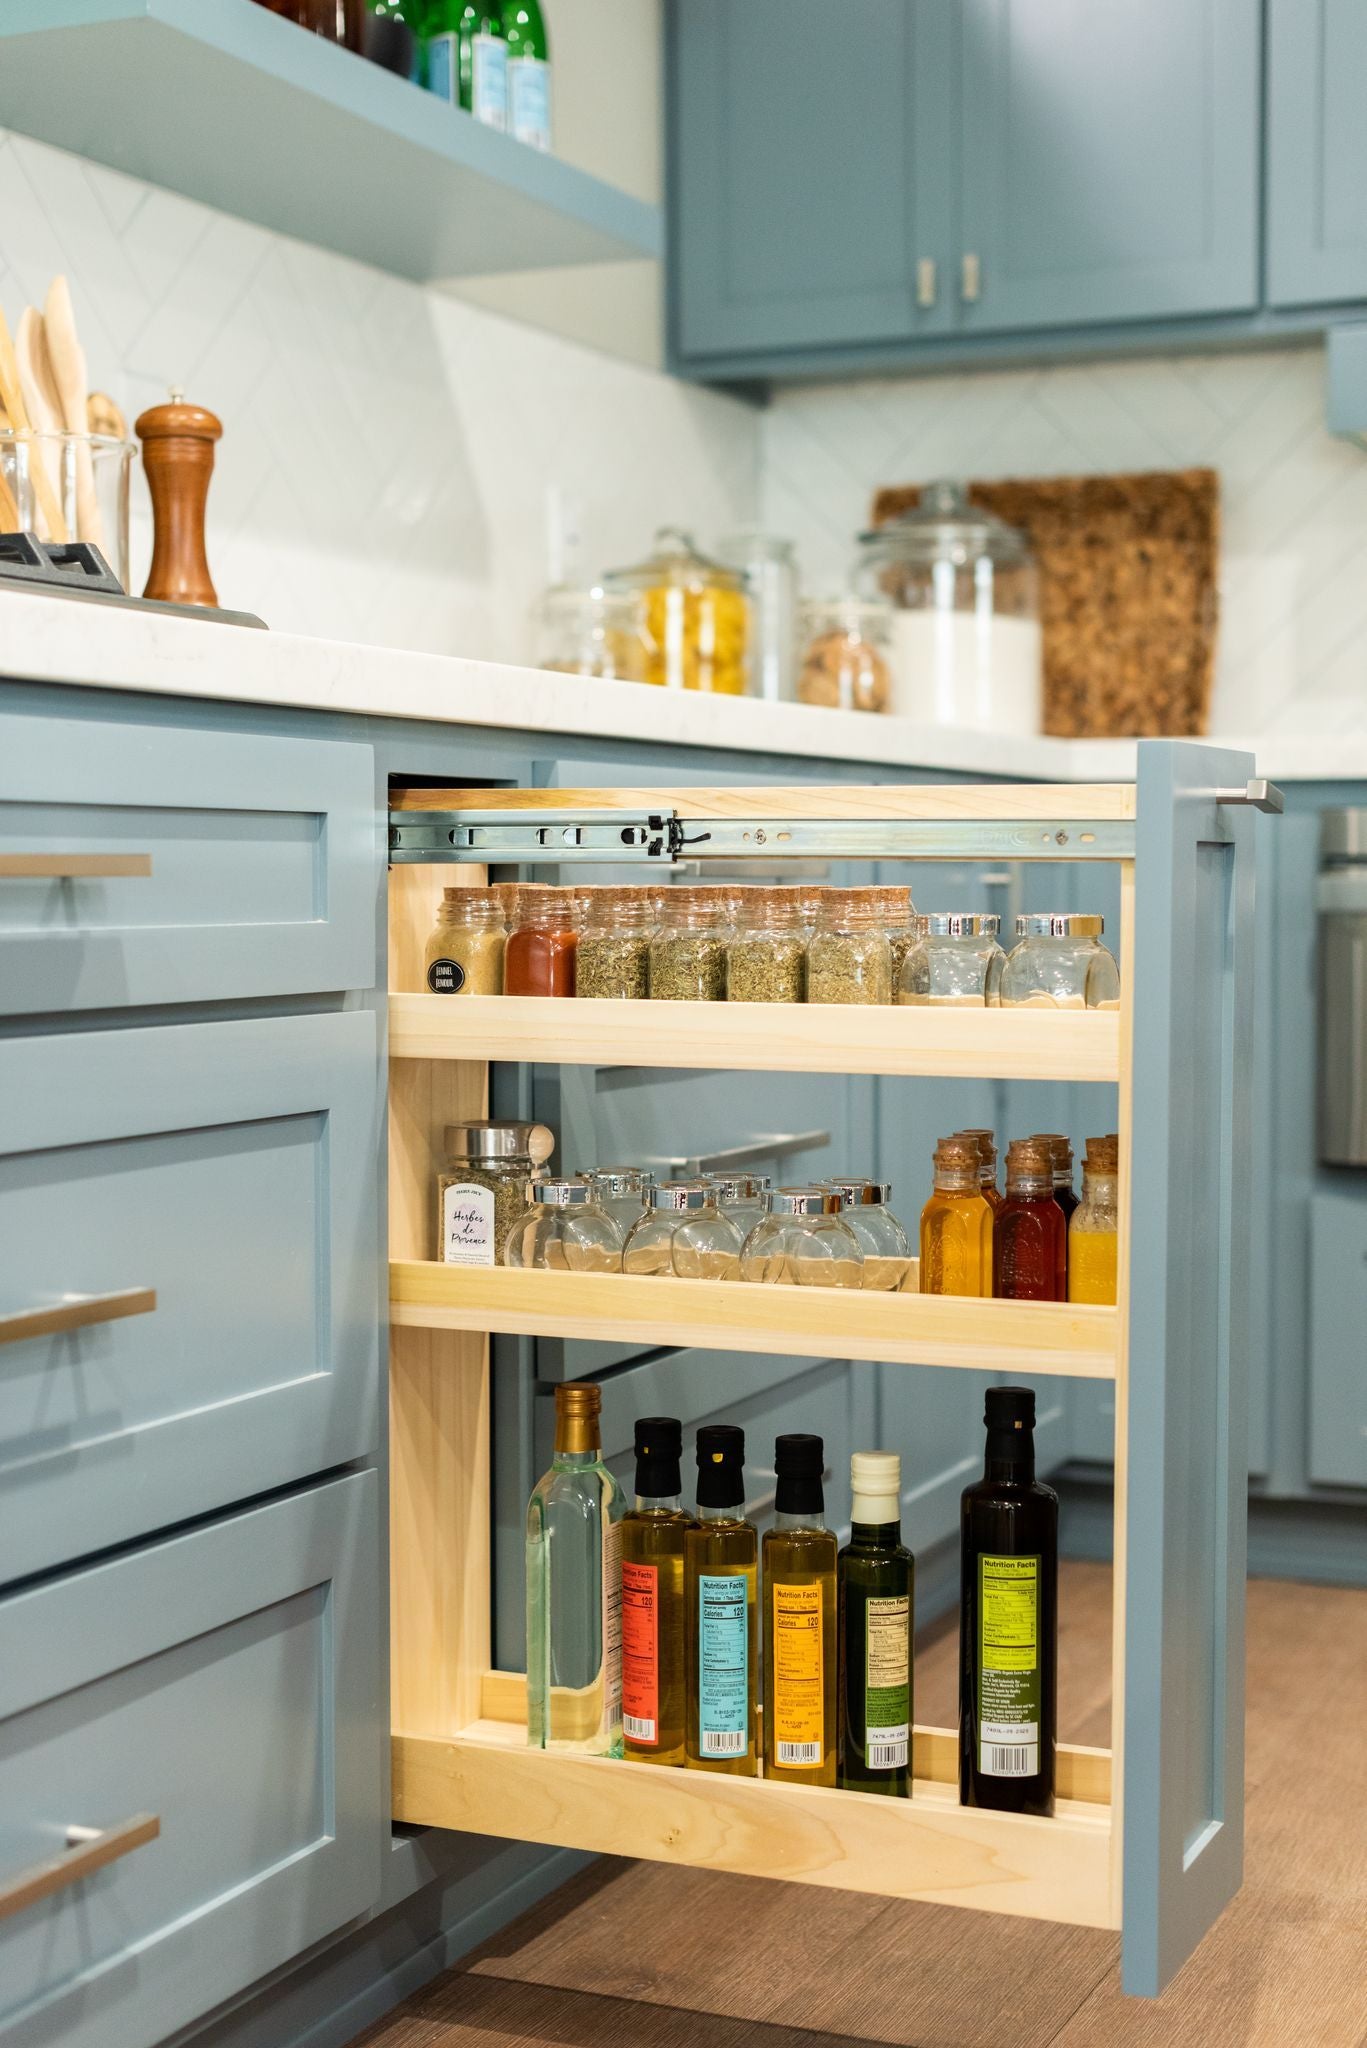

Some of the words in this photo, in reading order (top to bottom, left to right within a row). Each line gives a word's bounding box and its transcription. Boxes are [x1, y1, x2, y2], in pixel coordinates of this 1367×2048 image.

[453, 1210, 484, 1222] Herbes
[462, 1223, 474, 1234] de
[451, 1233, 487, 1245] Provence
[984, 1560, 1015, 1568] Nutrition
[704, 1582, 728, 1590] Nutrition
[778, 1591, 801, 1599] Nutrition
[642, 1596, 652, 1605] 120
[704, 1609, 723, 1617] Calories
[733, 1606, 744, 1616] 120
[778, 1617, 797, 1626] Calories
[807, 1617, 818, 1626] 120
